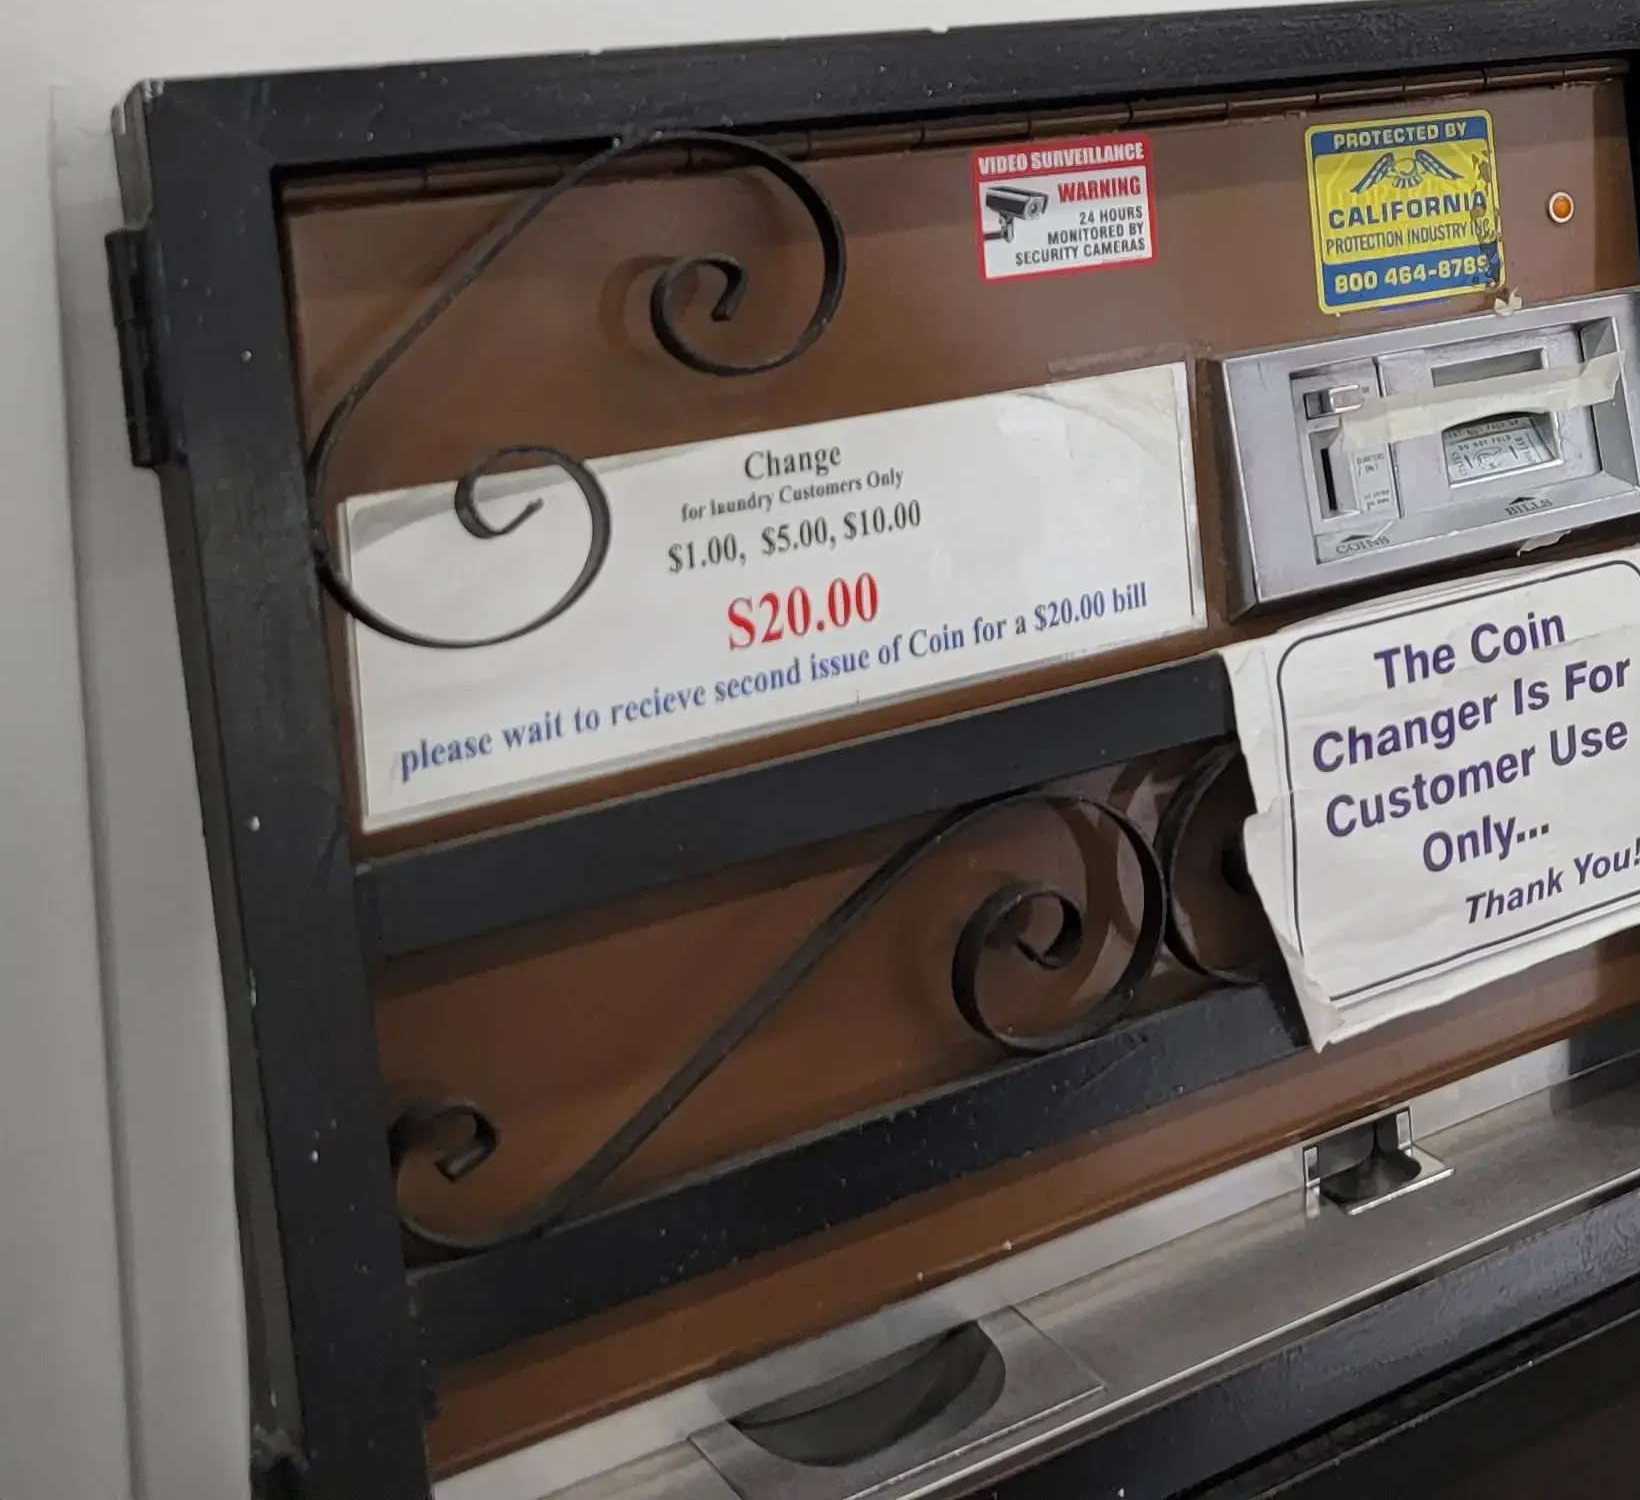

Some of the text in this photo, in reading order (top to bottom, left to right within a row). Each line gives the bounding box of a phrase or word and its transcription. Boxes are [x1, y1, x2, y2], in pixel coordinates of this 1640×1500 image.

[1333, 121, 1468, 150] PROTECTED BY
[978, 142, 1145, 175] VIDEO SURVEILLANCE
[1058, 175, 1142, 204] WARNING
[1079, 205, 1143, 225] 24 HOURS
[1328, 190, 1487, 230] CALIFORNIA
[1047, 221, 1144, 245] MONITORED BY
[1326, 230, 1403, 256] PROTECTION
[1407, 221, 1468, 243] INDUSTRY
[1015, 237, 1145, 267] SECURITY CAMERAS
[1334, 270, 1378, 294] 800
[744, 446, 842, 480] Change
[681, 467, 904, 523] for laundry Customers Only
[1504, 498, 1554, 517] BILLS
[667, 500, 921, 573] $1.00, $5.00, $10.00
[1335, 535, 1391, 555] COINS
[1374, 612, 1566, 690] The Coin
[399, 580, 1148, 785] please wait to recieve second issue of Coin for a $20.00 bill
[1312, 658, 1632, 773] Changer Is For
[1326, 720, 1629, 838] Customer Use
[1423, 815, 1551, 873] Only...
[1466, 867, 1564, 924] Thank
